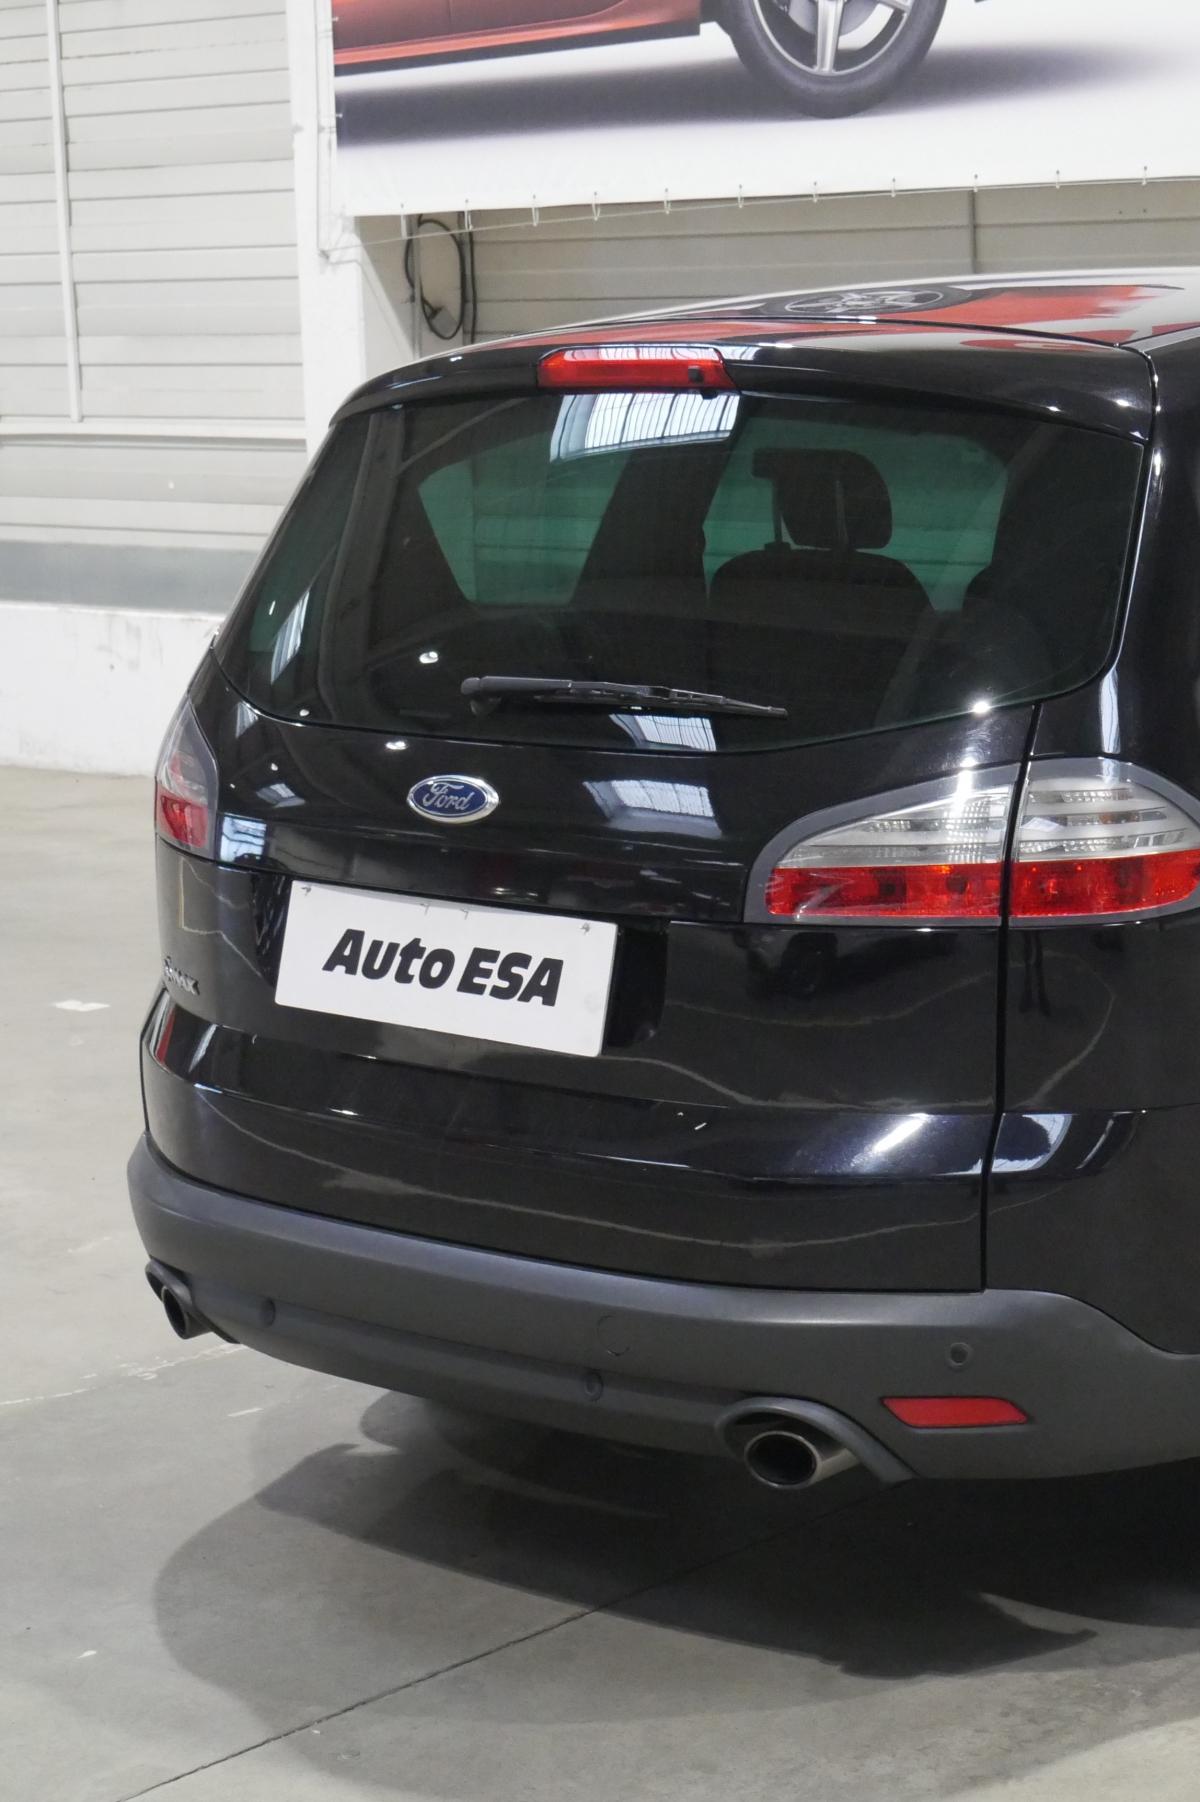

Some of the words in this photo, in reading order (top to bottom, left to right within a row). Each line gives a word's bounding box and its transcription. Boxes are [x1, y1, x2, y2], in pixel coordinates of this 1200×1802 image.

[422, 782, 475, 810] Ford
[322, 928, 455, 989] Auto
[456, 947, 564, 1007] ESA
